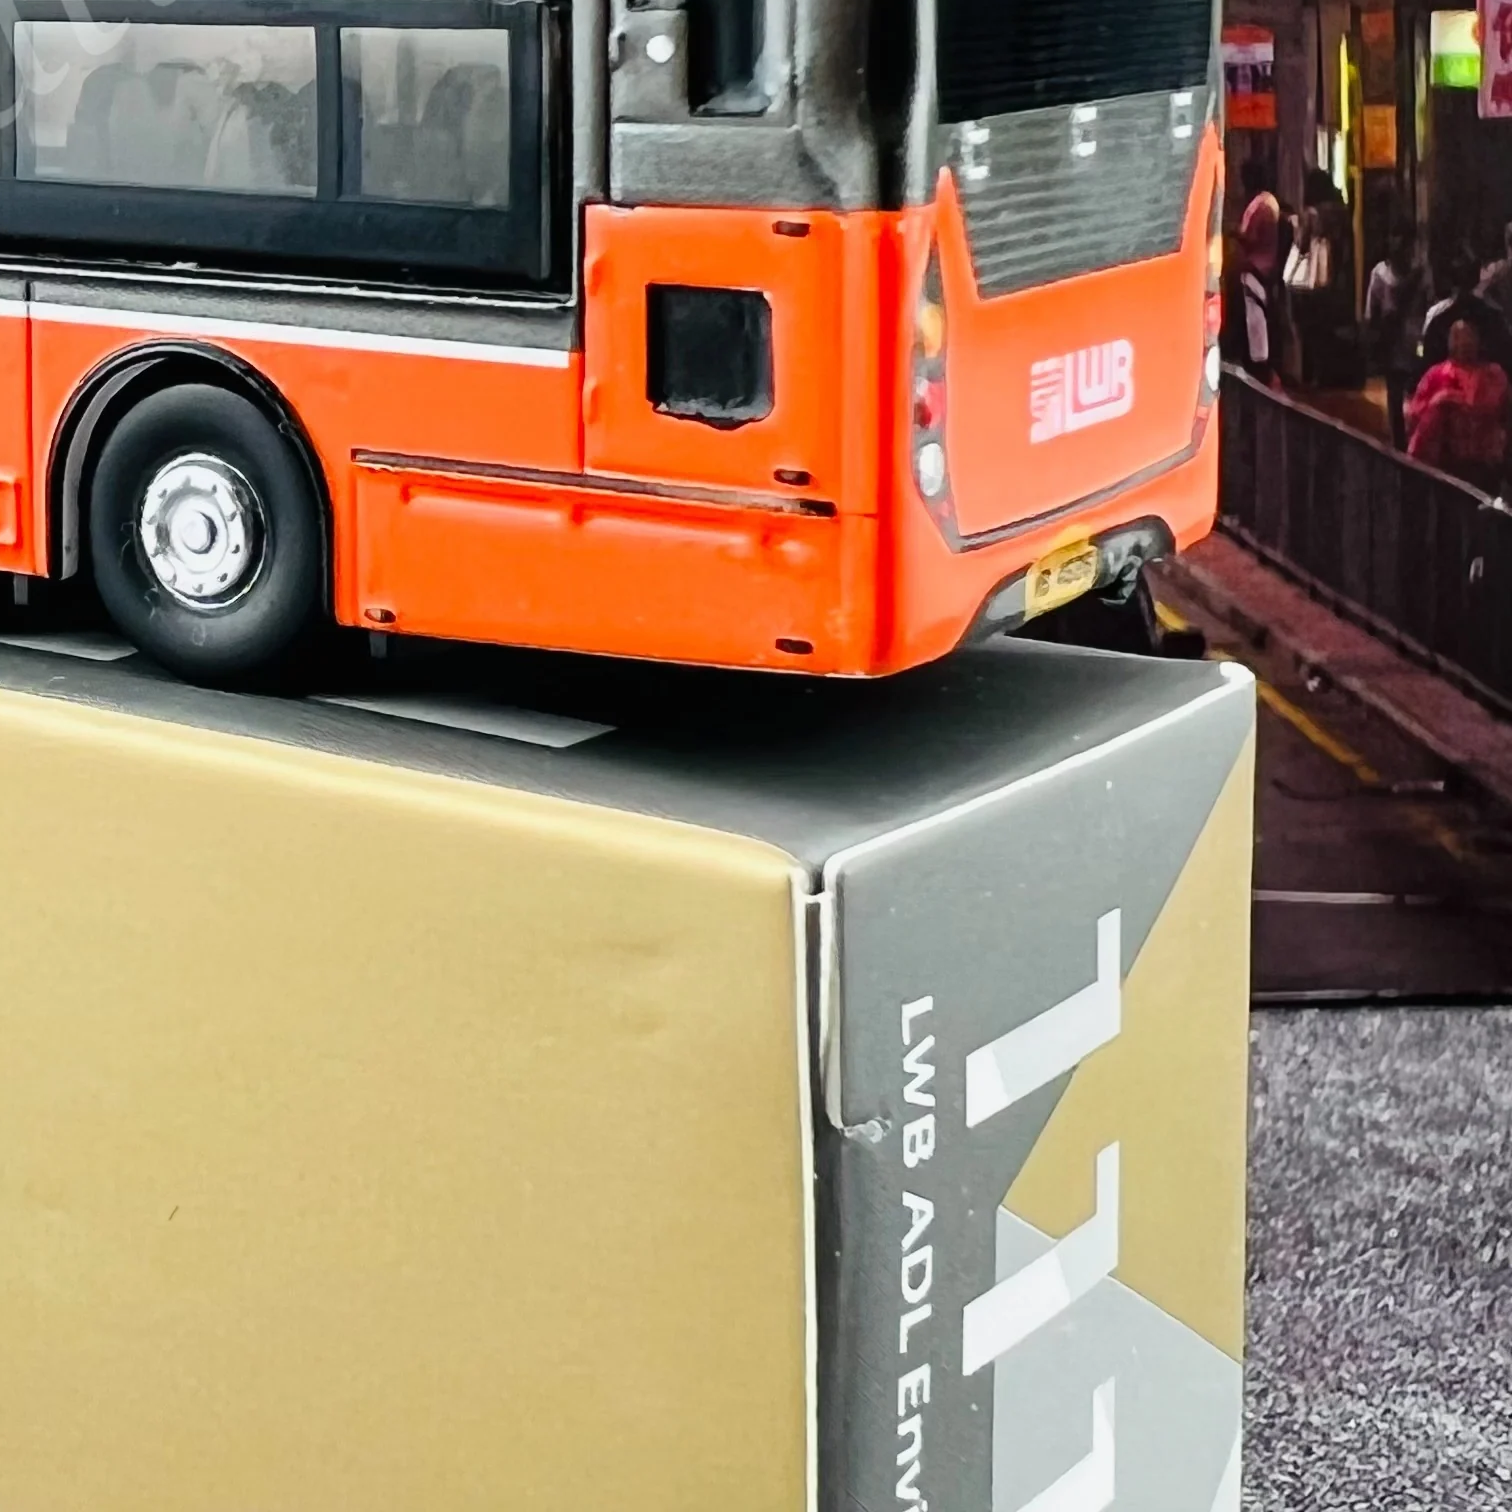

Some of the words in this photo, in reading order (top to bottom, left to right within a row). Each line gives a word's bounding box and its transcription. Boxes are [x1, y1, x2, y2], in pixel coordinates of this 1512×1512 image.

[1063, 337, 1135, 434] LWB
[900, 995, 936, 1169] LWB
[898, 1191, 935, 1354] ADL
